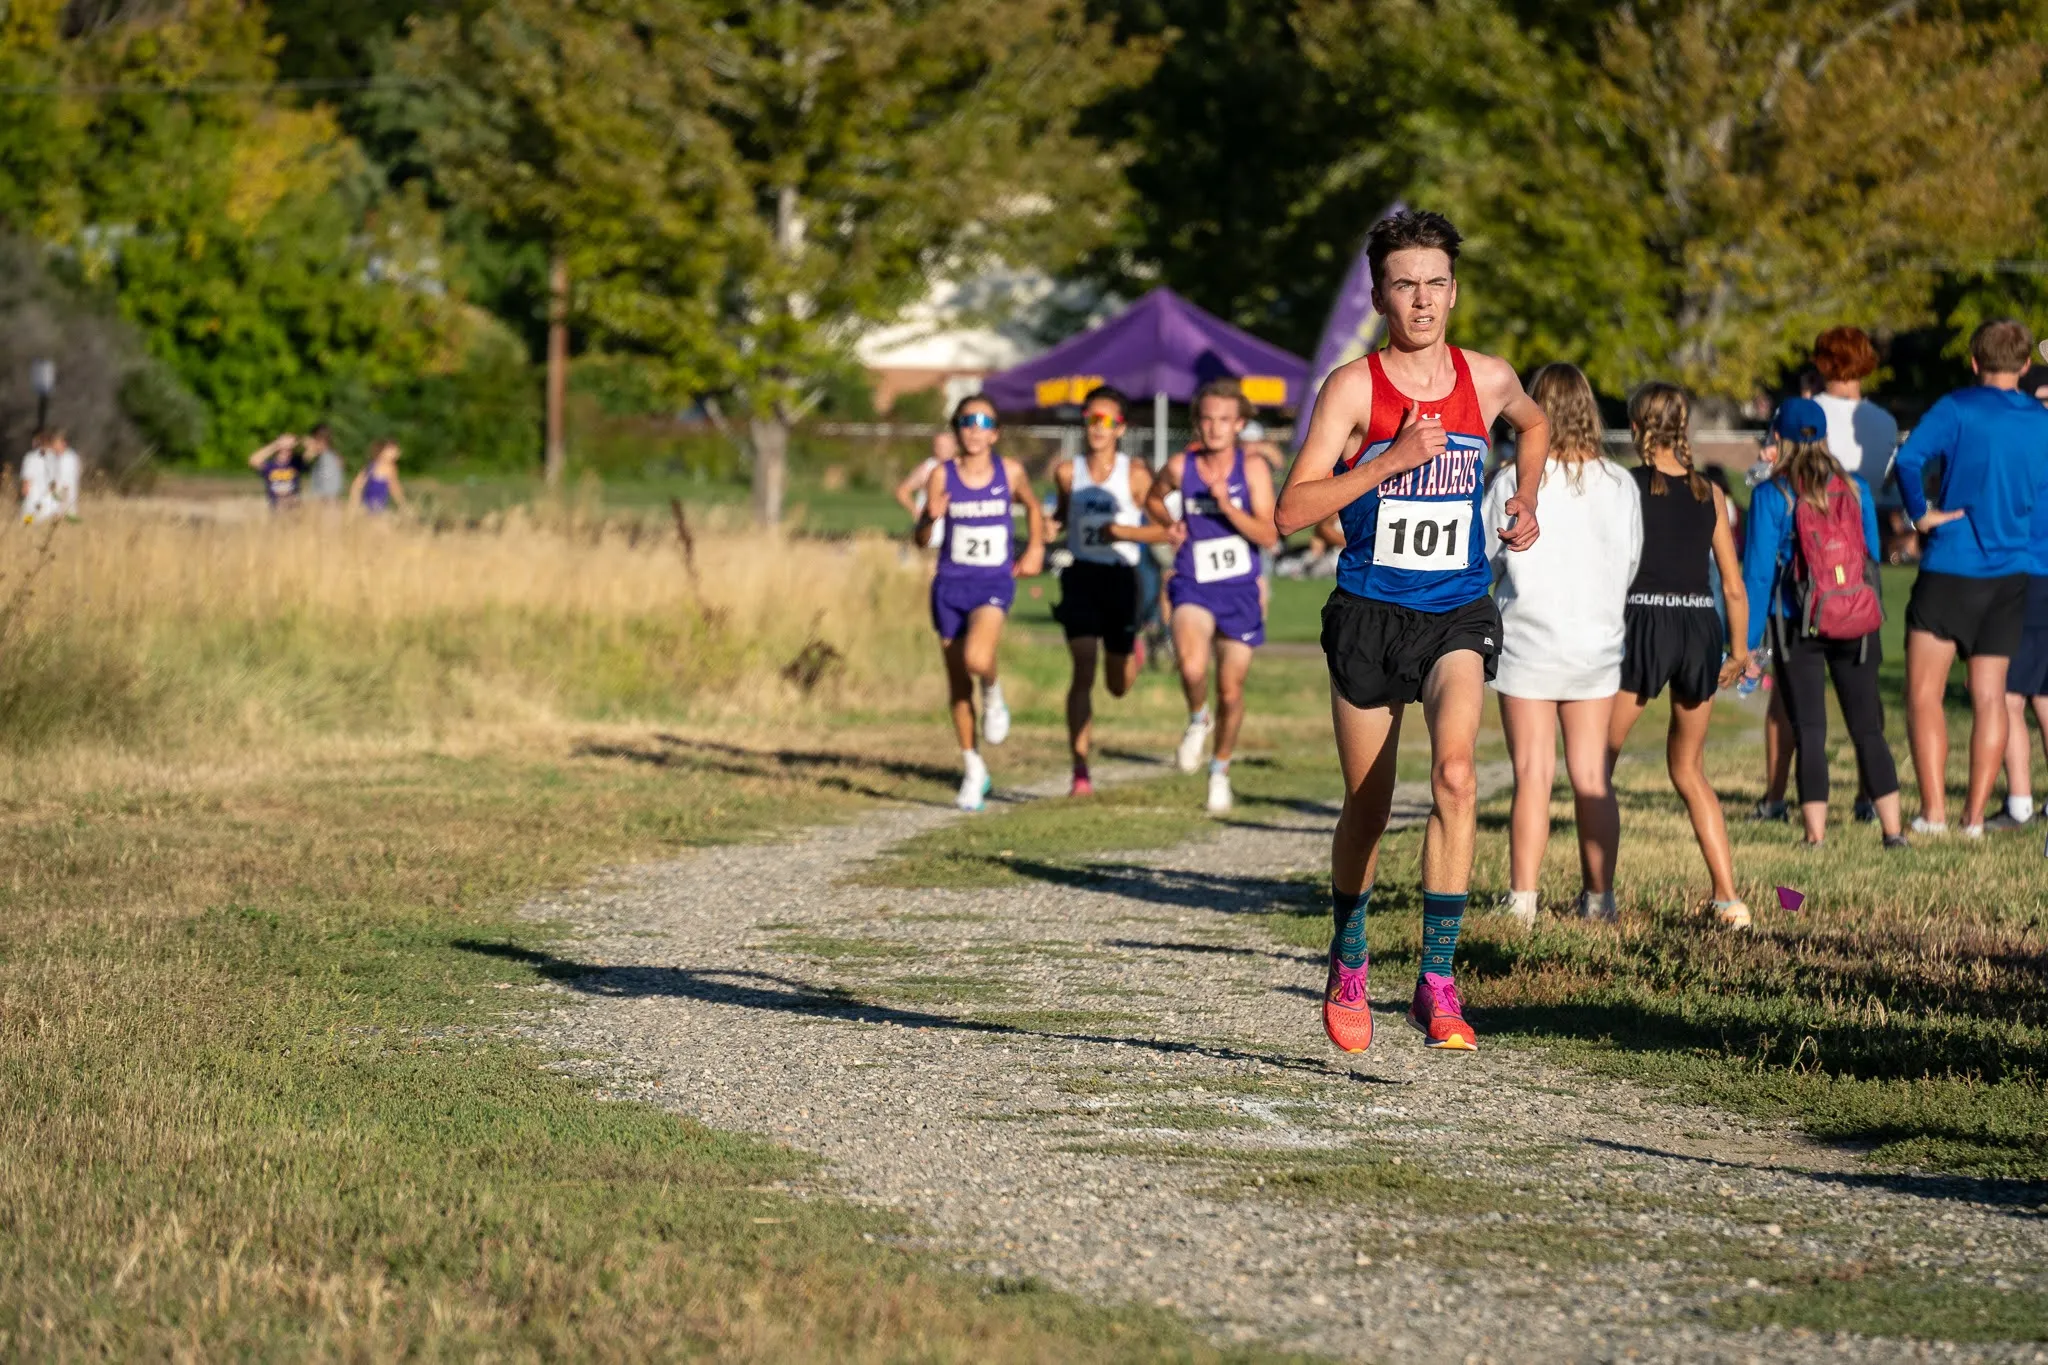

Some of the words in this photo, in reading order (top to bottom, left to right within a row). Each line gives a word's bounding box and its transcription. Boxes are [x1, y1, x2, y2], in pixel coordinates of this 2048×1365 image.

[966, 539, 990, 556] 21
[1388, 518, 1458, 557] 101
[1209, 549, 1237, 570] 19
